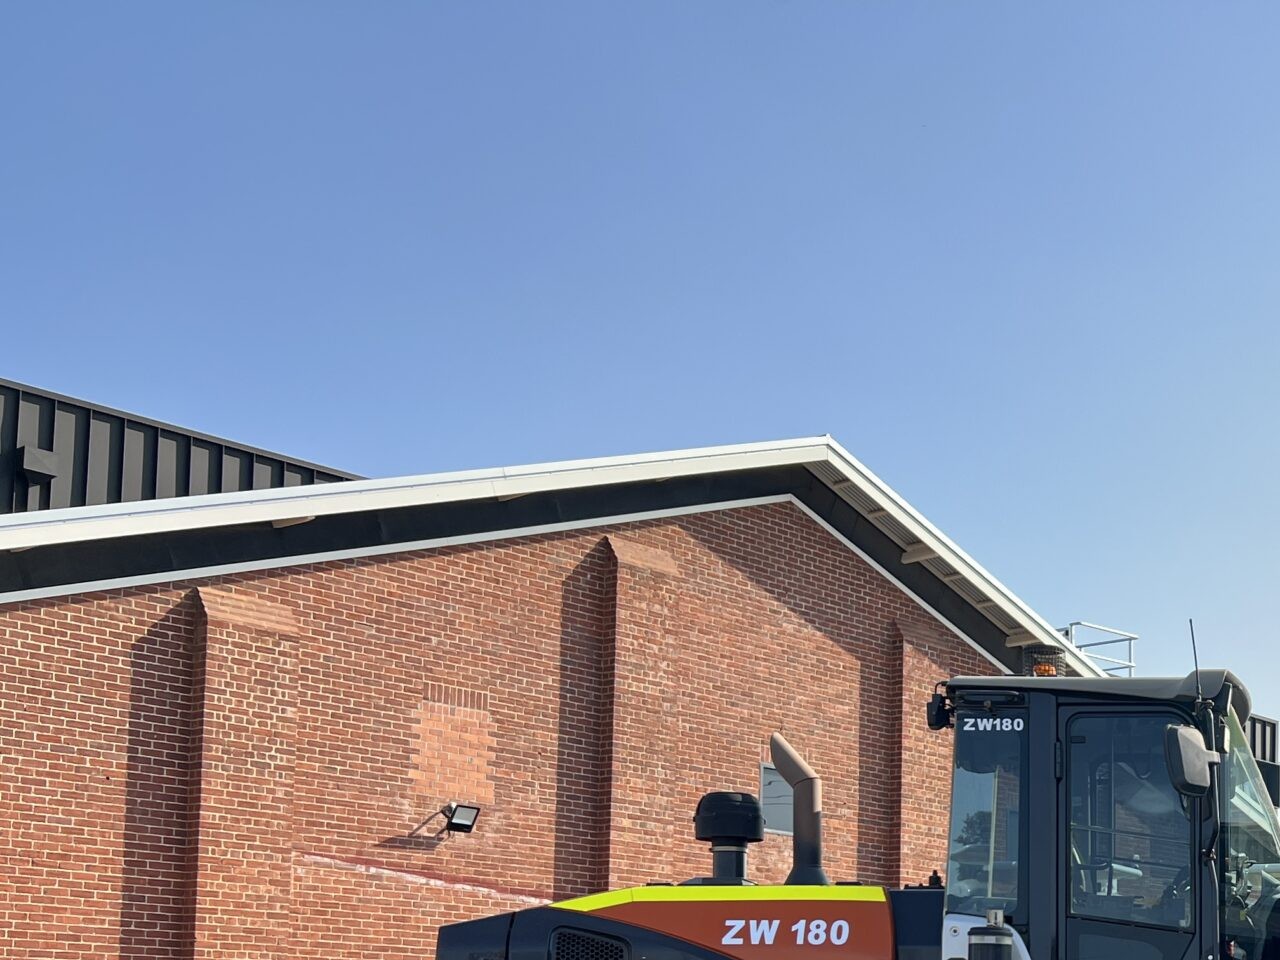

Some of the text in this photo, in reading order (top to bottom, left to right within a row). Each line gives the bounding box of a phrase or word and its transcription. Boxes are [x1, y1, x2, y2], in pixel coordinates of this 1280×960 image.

[963, 718, 1024, 731] ZW180
[721, 919, 850, 946] ZW 180
